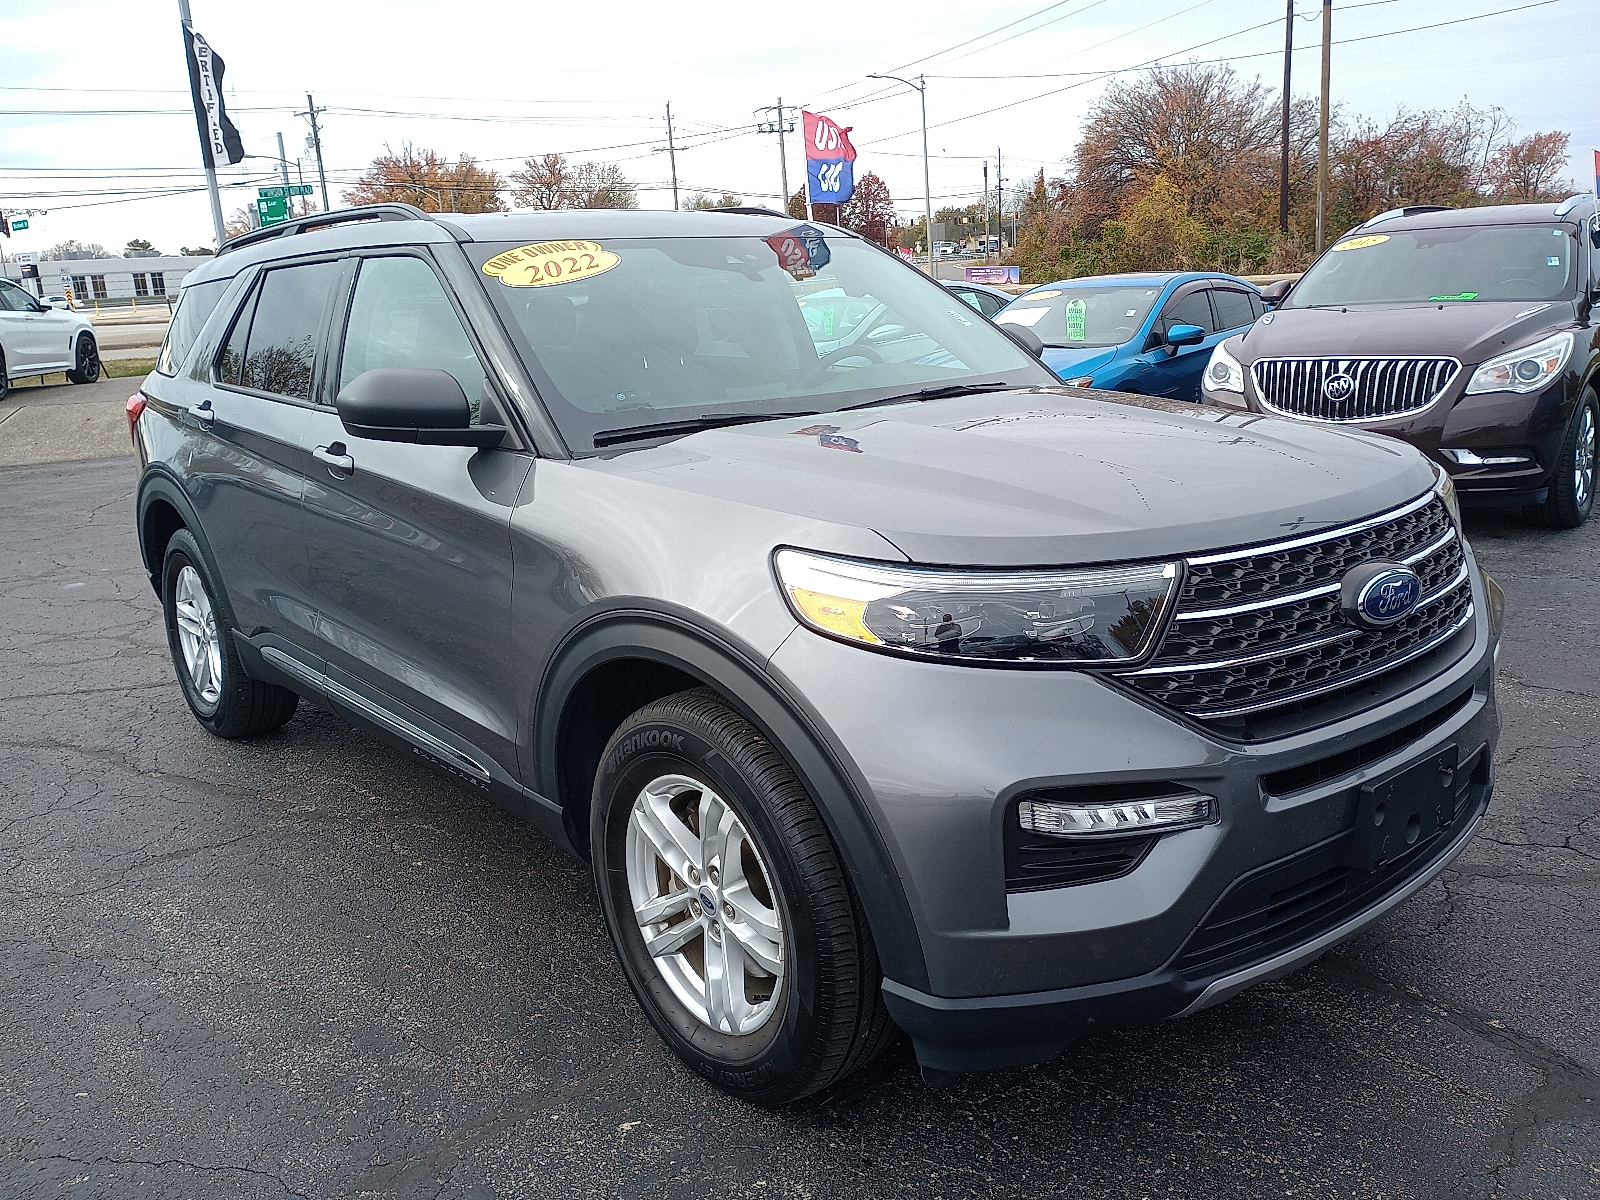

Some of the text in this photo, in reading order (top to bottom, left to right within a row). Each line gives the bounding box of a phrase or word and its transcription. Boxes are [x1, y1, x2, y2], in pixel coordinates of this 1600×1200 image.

[195, 34, 223, 154] ERTIFED
[487, 241, 588, 270] ONE OWNER
[524, 253, 600, 284] 2022
[1379, 580, 1412, 613] Ford
